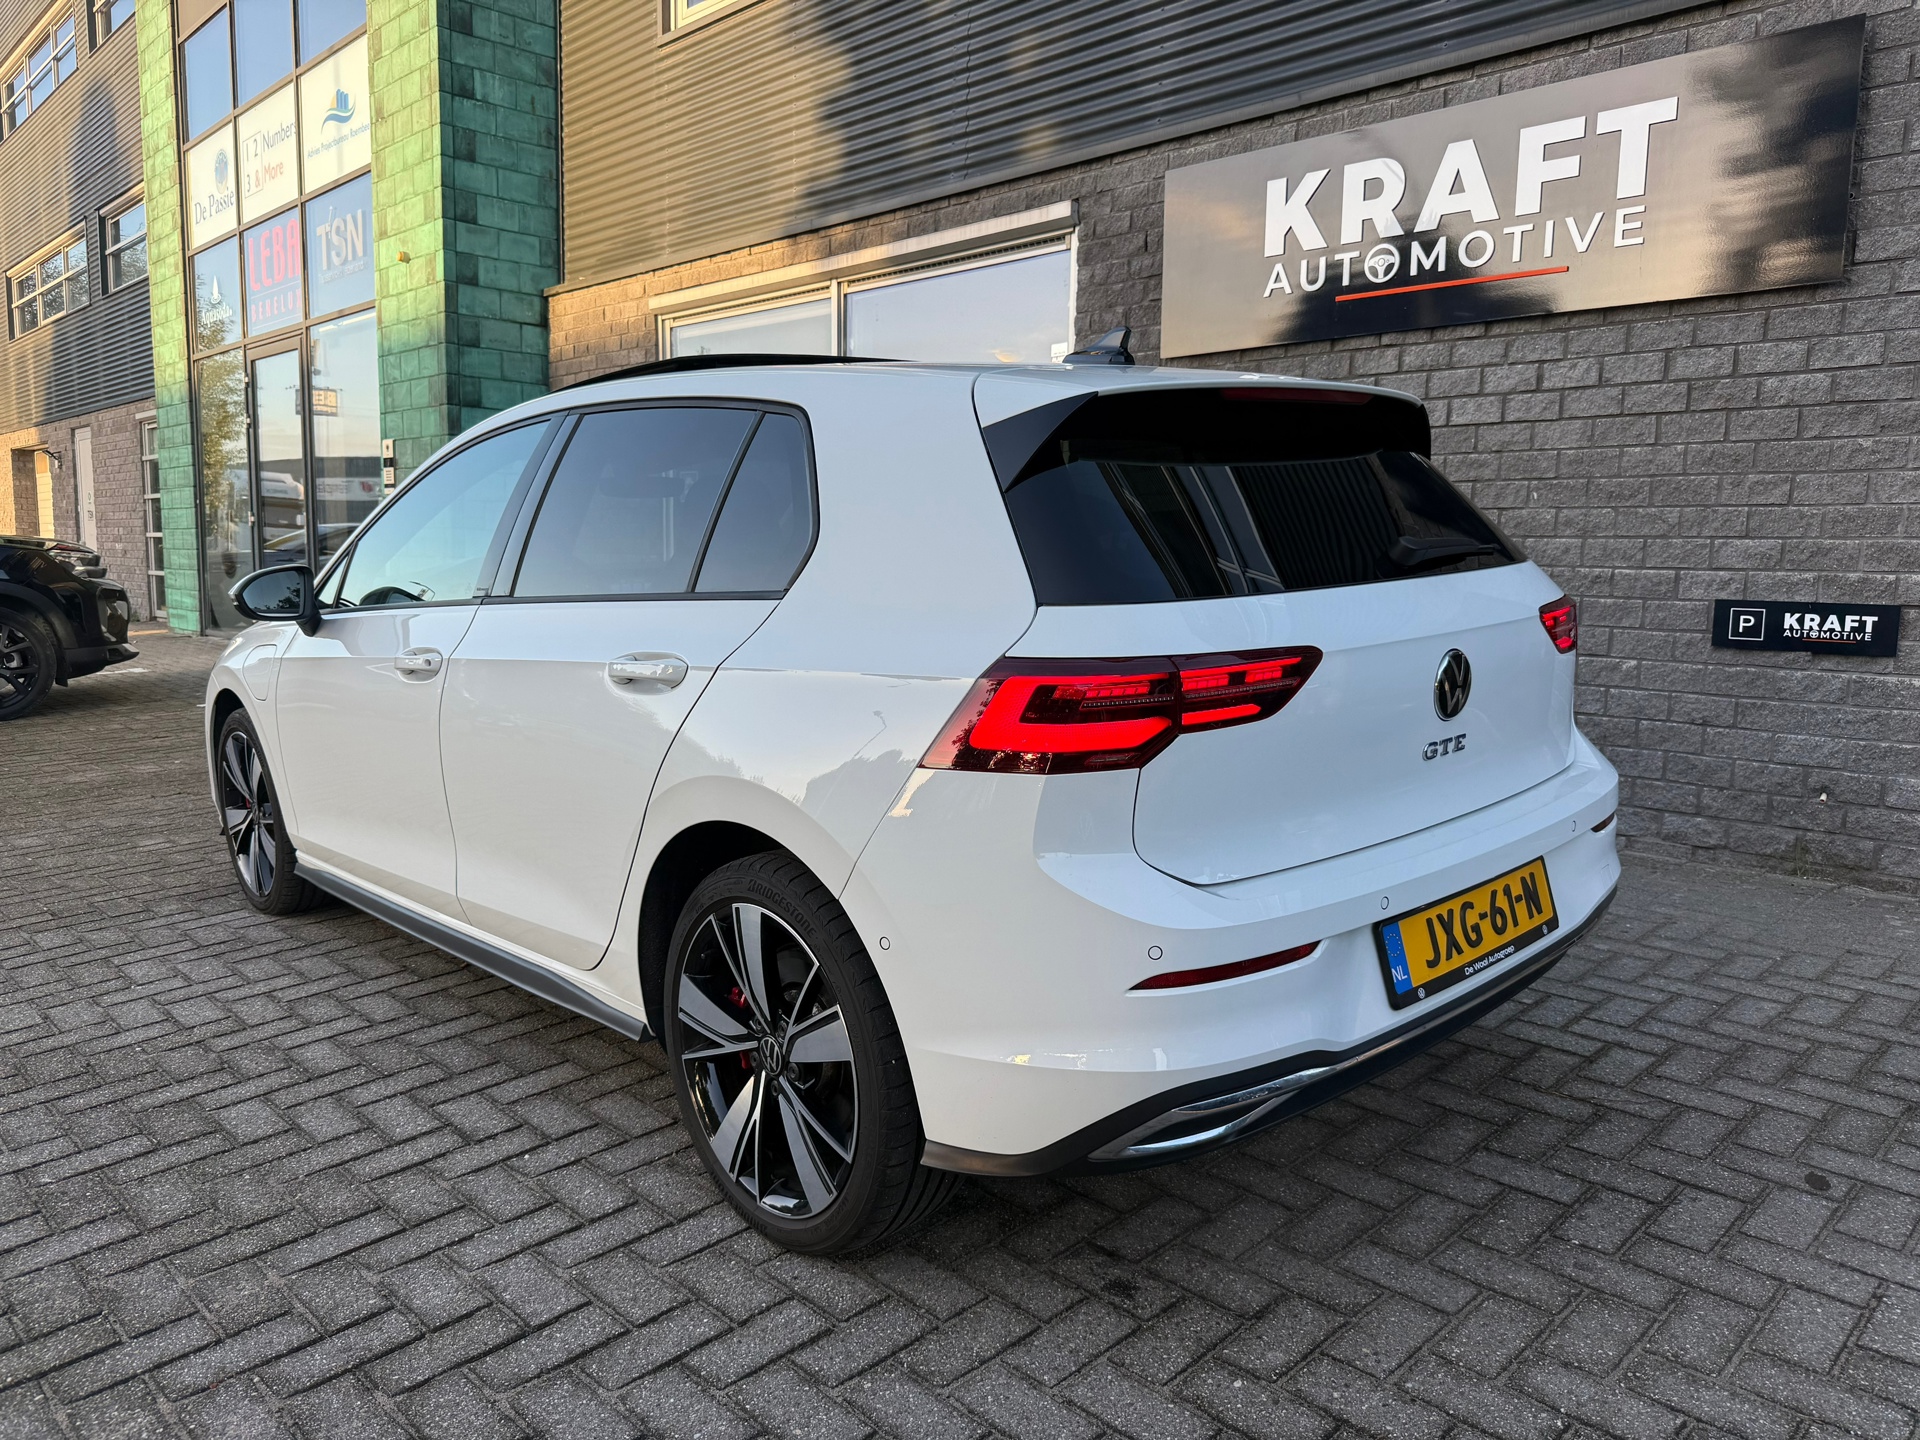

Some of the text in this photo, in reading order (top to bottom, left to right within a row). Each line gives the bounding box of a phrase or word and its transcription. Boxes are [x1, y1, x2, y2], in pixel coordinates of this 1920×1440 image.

[253, 138, 259, 158] 2
[262, 121, 297, 152] Numbers
[246, 174, 251, 193] 3
[263, 162, 284, 184] More
[1264, 97, 1679, 258] KRAFT
[194, 186, 235, 225] De Passie
[248, 217, 300, 291] LEBA
[316, 208, 364, 271] TSN
[1263, 206, 1647, 298] AUTOMOTIVE
[1739, 615, 1755, 633] P
[1783, 612, 1879, 633] KRAFT
[1783, 629, 1872, 641] AUTOMOTIVE
[1422, 733, 1467, 761] GTE
[747, 879, 816, 938] BRIDGESTONE
[1425, 872, 1543, 969] JXG-61-N
[1391, 964, 1408, 983] NL
[1464, 966, 1474, 976] De
